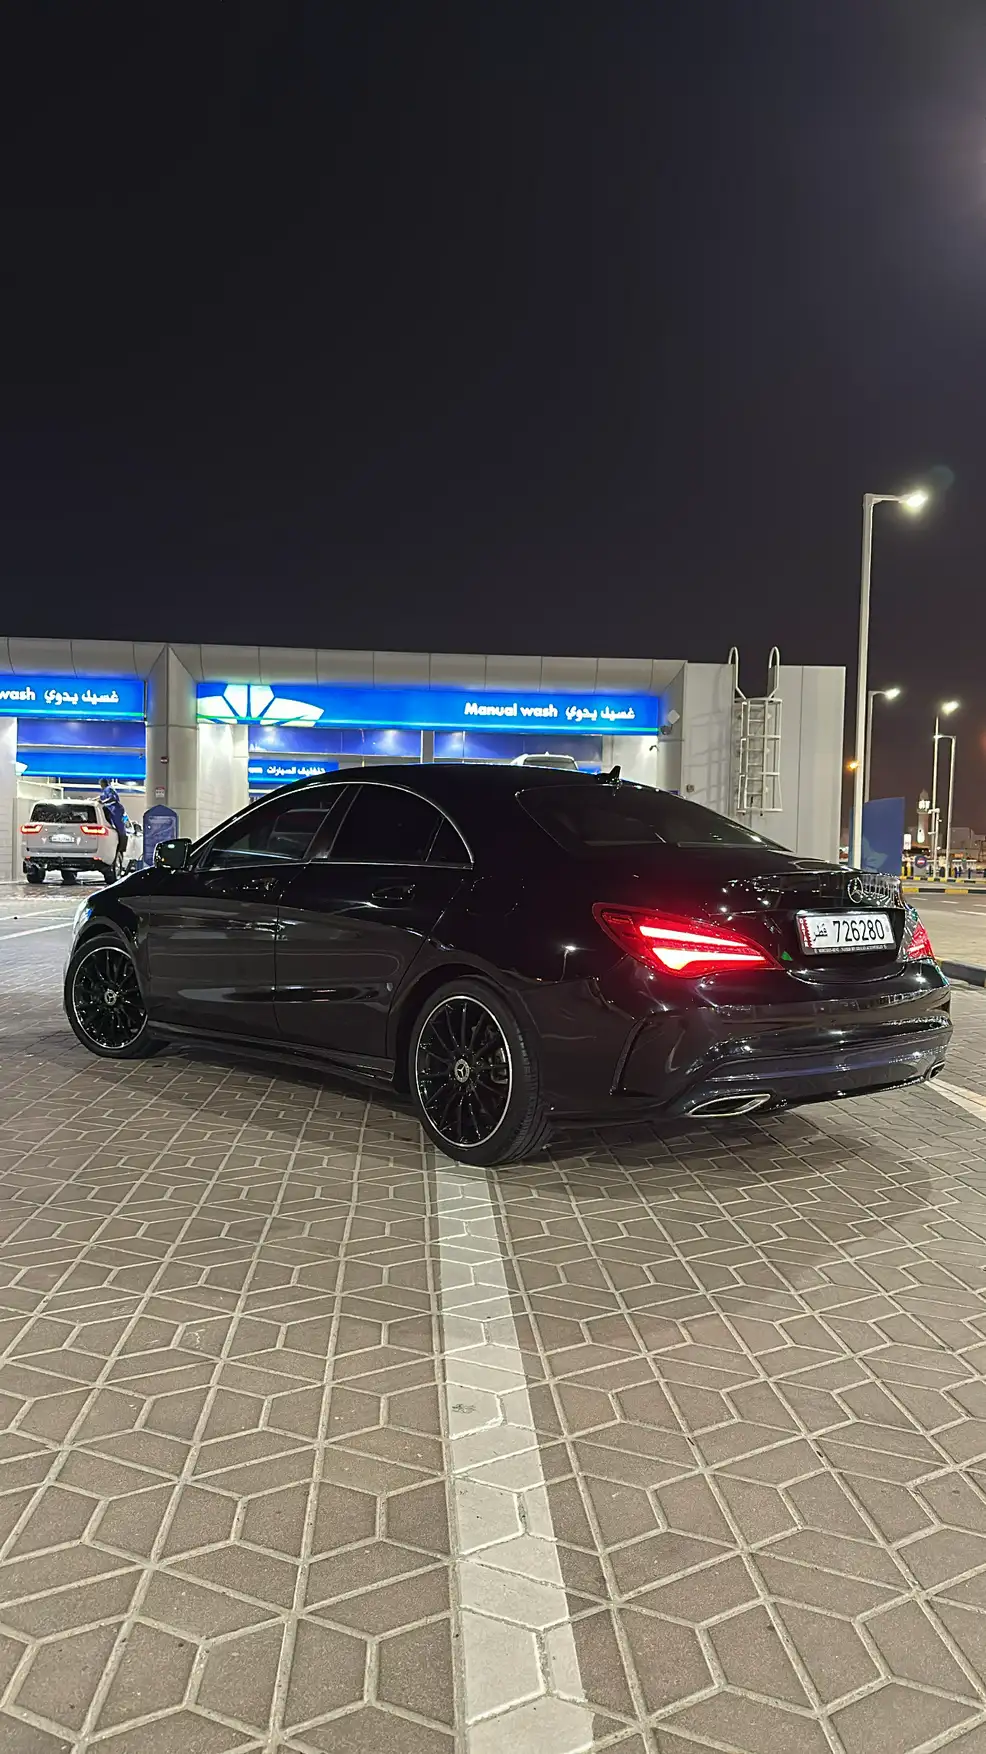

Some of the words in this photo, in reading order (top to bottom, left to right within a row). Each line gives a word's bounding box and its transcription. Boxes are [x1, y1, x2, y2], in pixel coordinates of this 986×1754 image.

[44, 689, 79, 705] يدوي
[81, 689, 119, 705] غسيل
[464, 702, 517, 717] Manual
[520, 703, 558, 718] wash
[565, 705, 597, 722] يدوي
[600, 706, 635, 722] غسيل
[799, 918, 809, 948] QATAR
[833, 918, 885, 943] 726280
